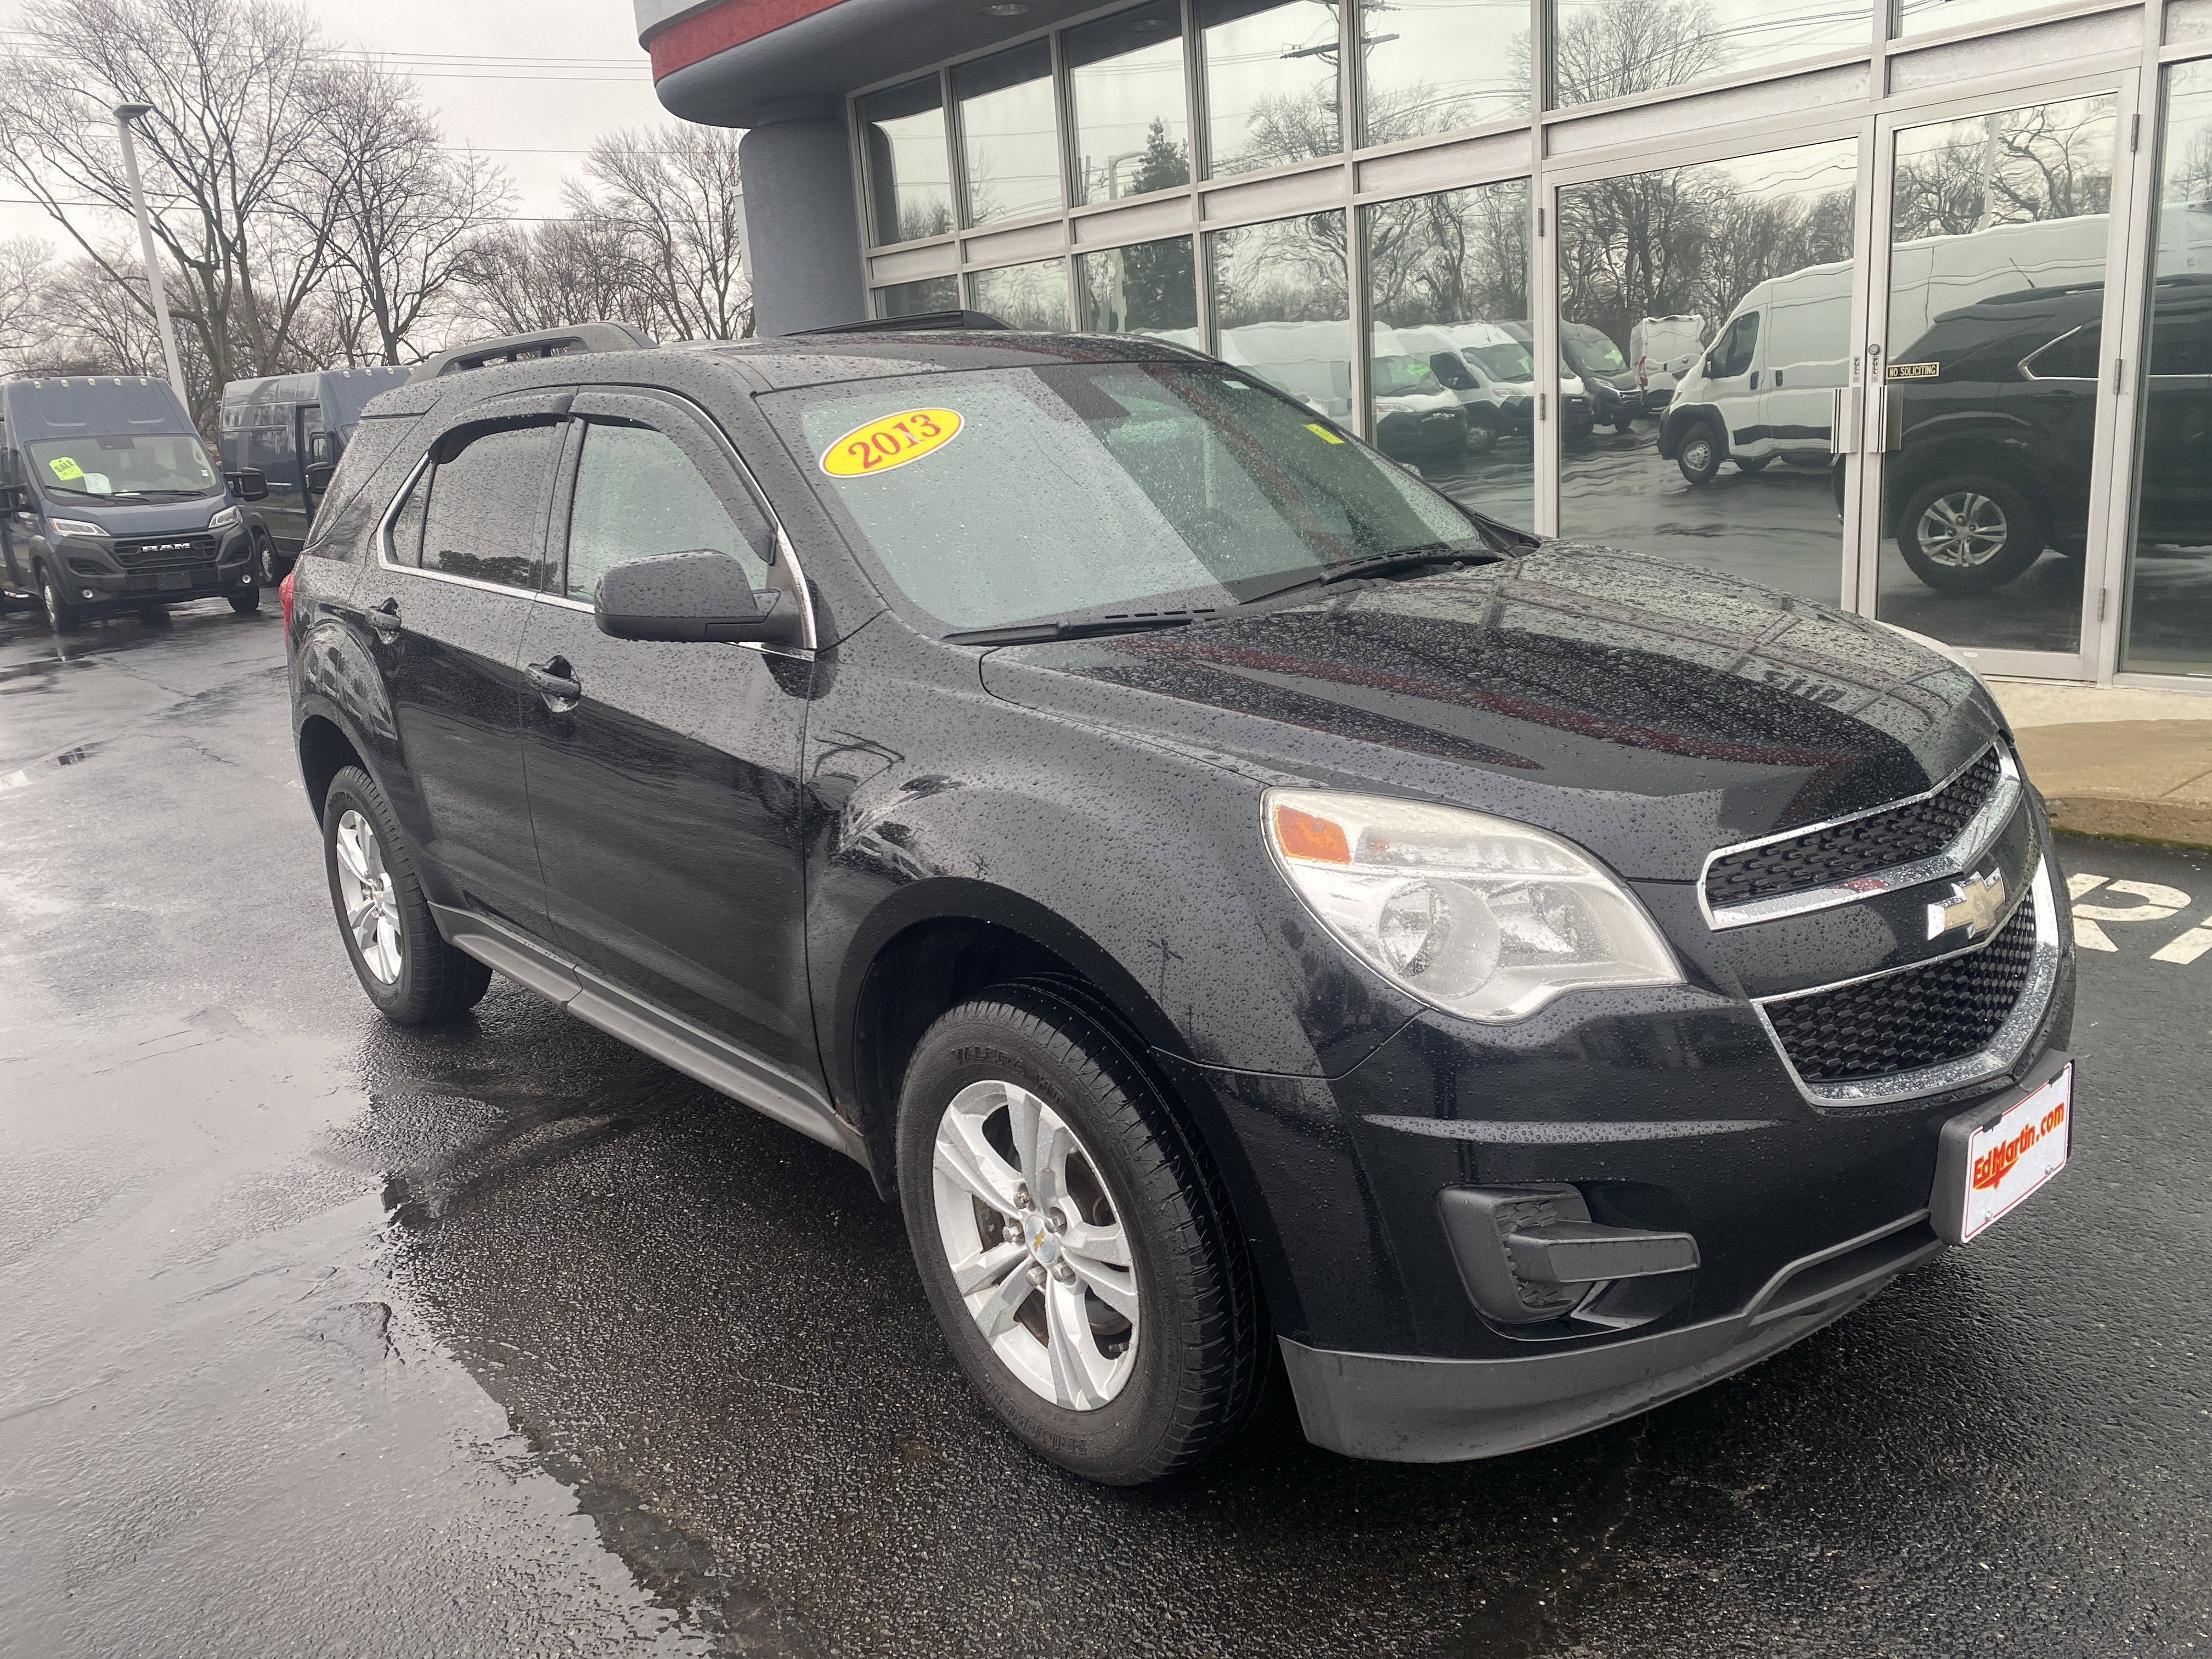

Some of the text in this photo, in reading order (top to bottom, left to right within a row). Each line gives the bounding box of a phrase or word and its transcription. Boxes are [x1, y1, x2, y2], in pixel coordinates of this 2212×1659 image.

[1889, 365, 1936, 377] NO SOLICITING
[848, 414, 941, 469] 2013
[54, 459, 75, 473] SALE
[142, 543, 190, 552] RAM
[1973, 1103, 2064, 1188] EdMartin.com
